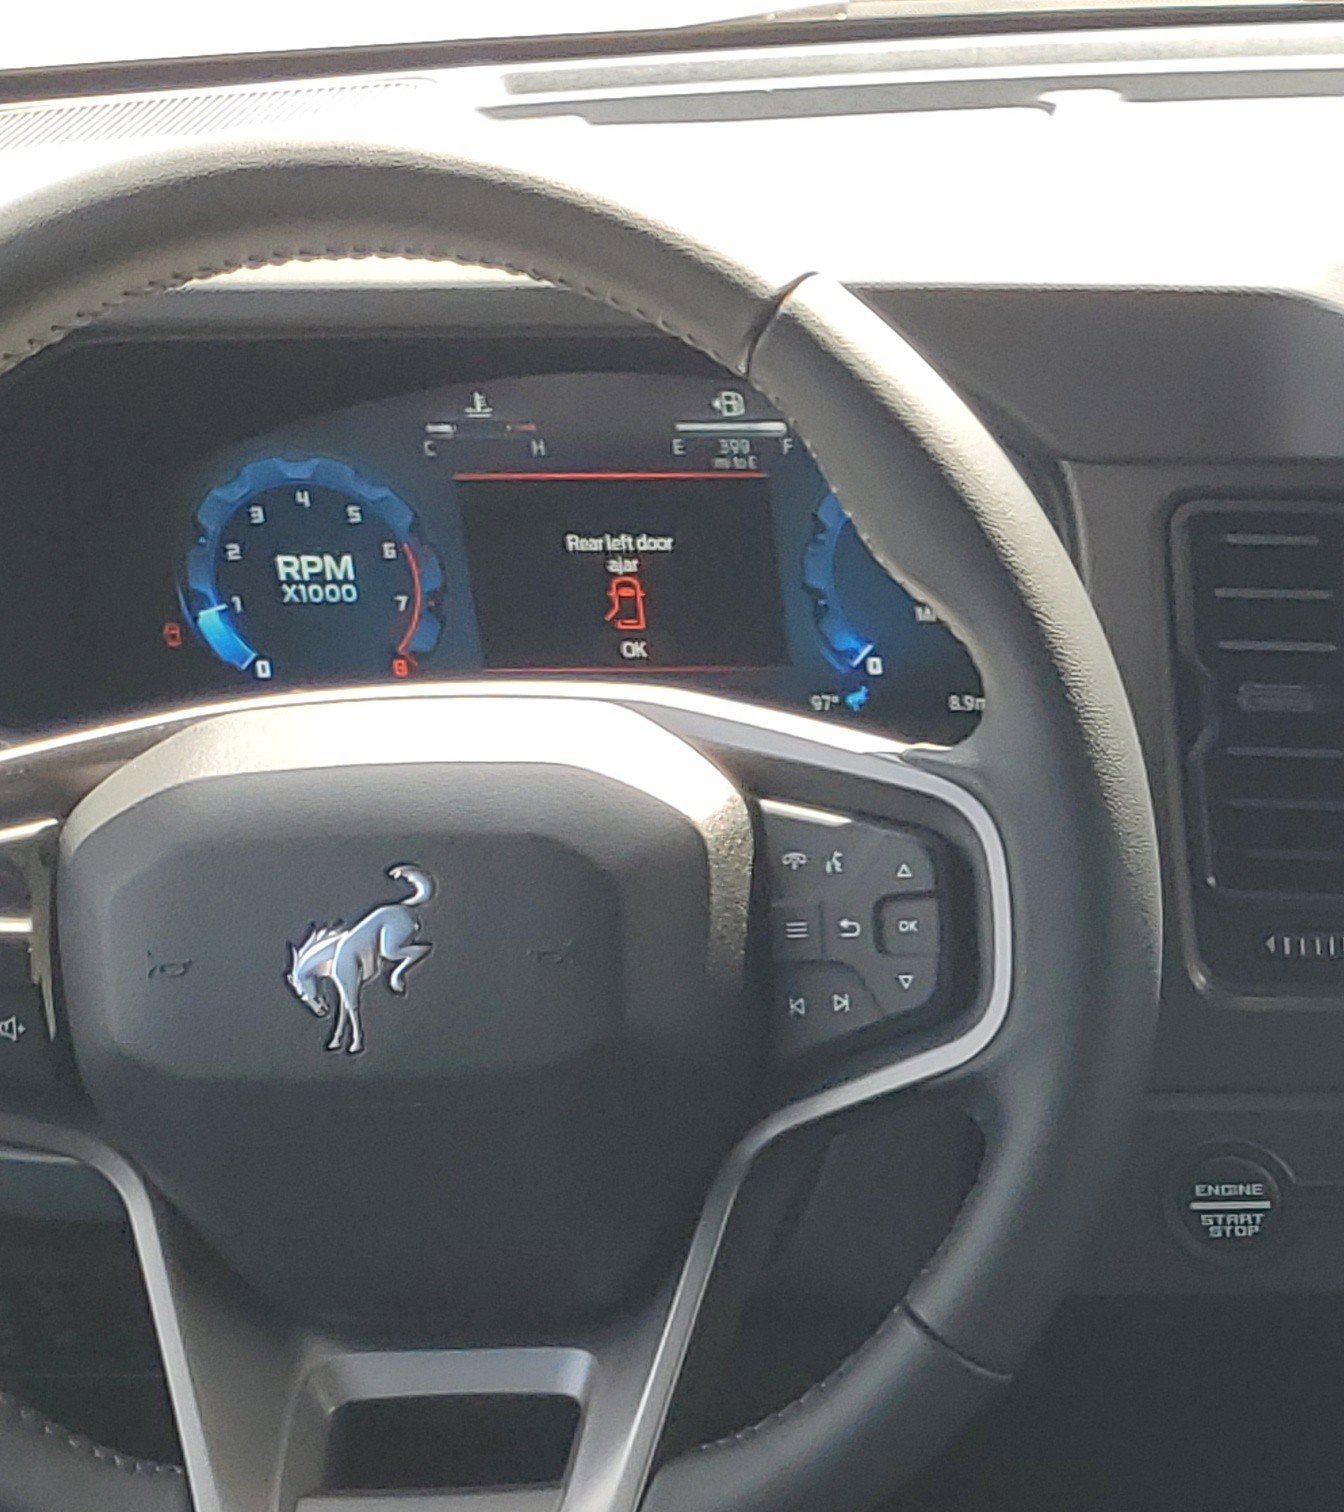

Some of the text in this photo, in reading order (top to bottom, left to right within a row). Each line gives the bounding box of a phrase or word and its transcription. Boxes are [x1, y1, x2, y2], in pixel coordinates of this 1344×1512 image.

[424, 440, 436, 456] C
[531, 439, 545, 456] H
[672, 439, 686, 455] E
[783, 438, 794, 456] F
[296, 491, 311, 508] 4
[249, 505, 265, 524] 3
[346, 506, 362, 524] 5
[382, 542, 398, 559] 6
[566, 533, 674, 551] Rear left door
[225, 543, 243, 561] 2
[275, 554, 356, 581] RPM
[606, 555, 639, 575] ajar
[231, 596, 243, 613] 1
[394, 596, 408, 611] 7
[620, 641, 648, 659] OK
[256, 660, 271, 678] 0
[866, 656, 883, 675] 0
[898, 919, 918, 934] OK
[1195, 1183, 1263, 1197] ENGINE
[1200, 1213, 1265, 1226] START
[1208, 1225, 1261, 1238] STOP
